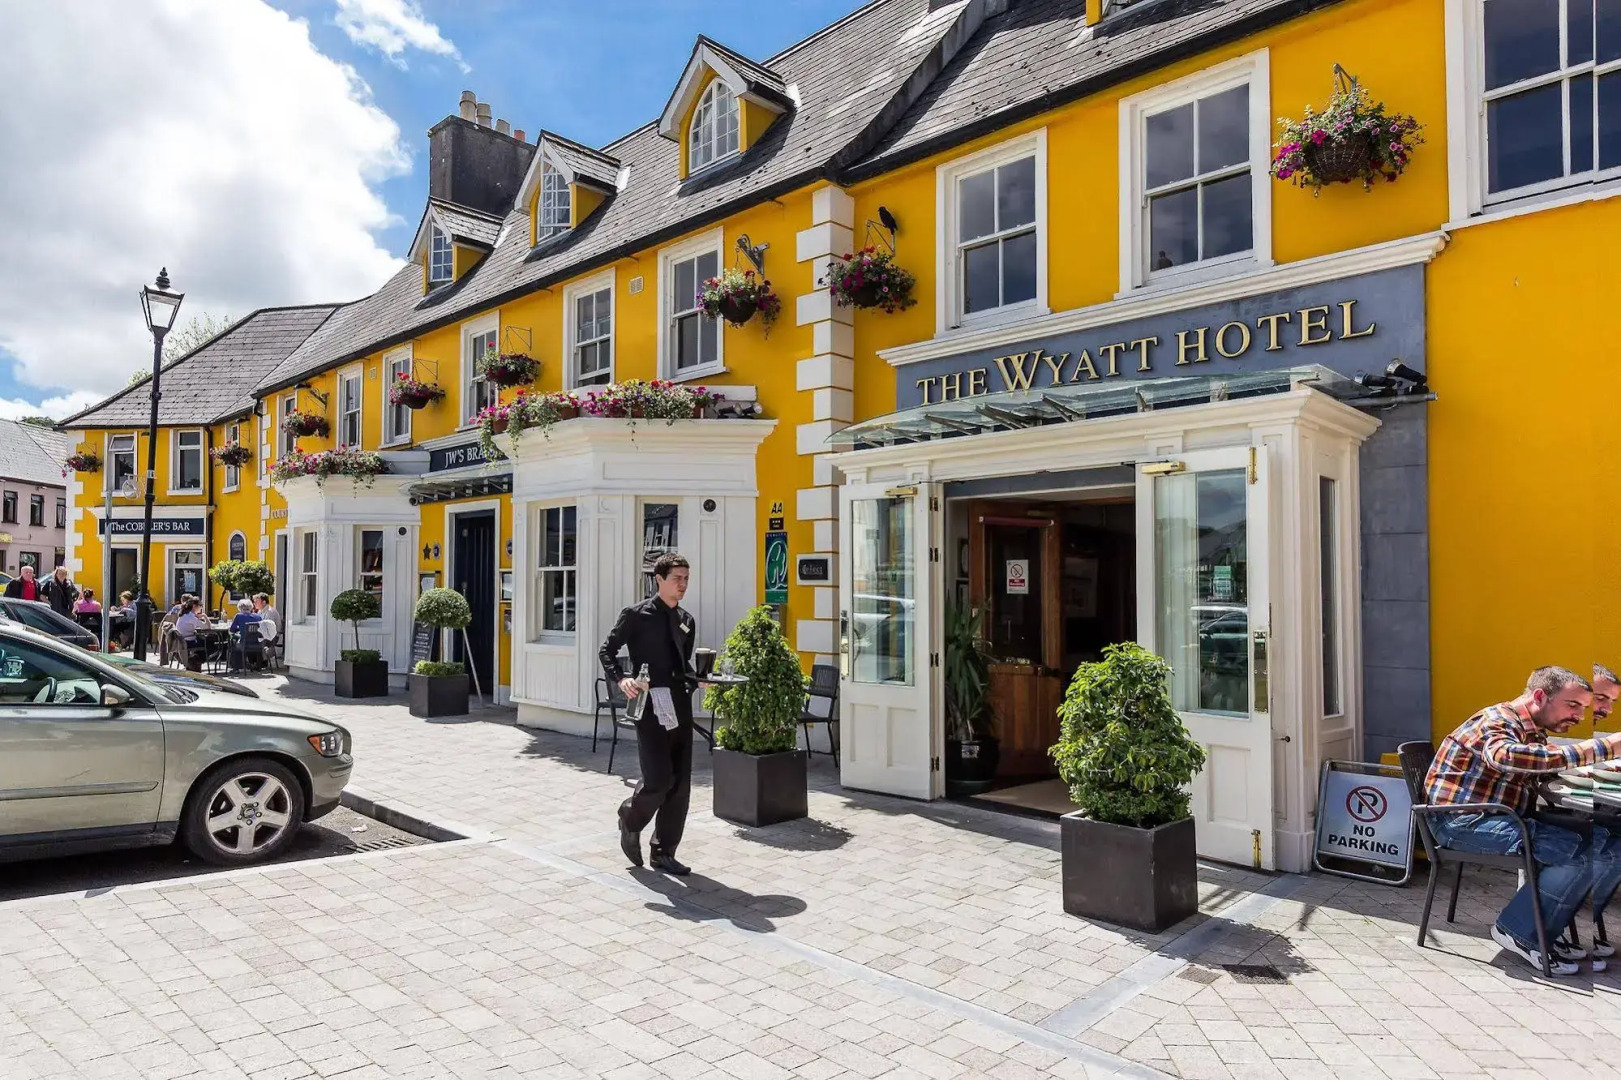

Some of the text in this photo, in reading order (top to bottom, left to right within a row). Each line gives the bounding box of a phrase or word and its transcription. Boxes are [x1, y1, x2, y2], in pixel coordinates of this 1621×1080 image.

[916, 299, 1377, 406] THE WYATT HOTEL
[444, 448, 465, 468] JW'S
[112, 521, 191, 532] The COBER'S BAR
[1353, 824, 1375, 837] NO
[1327, 834, 1399, 856] PARKING
